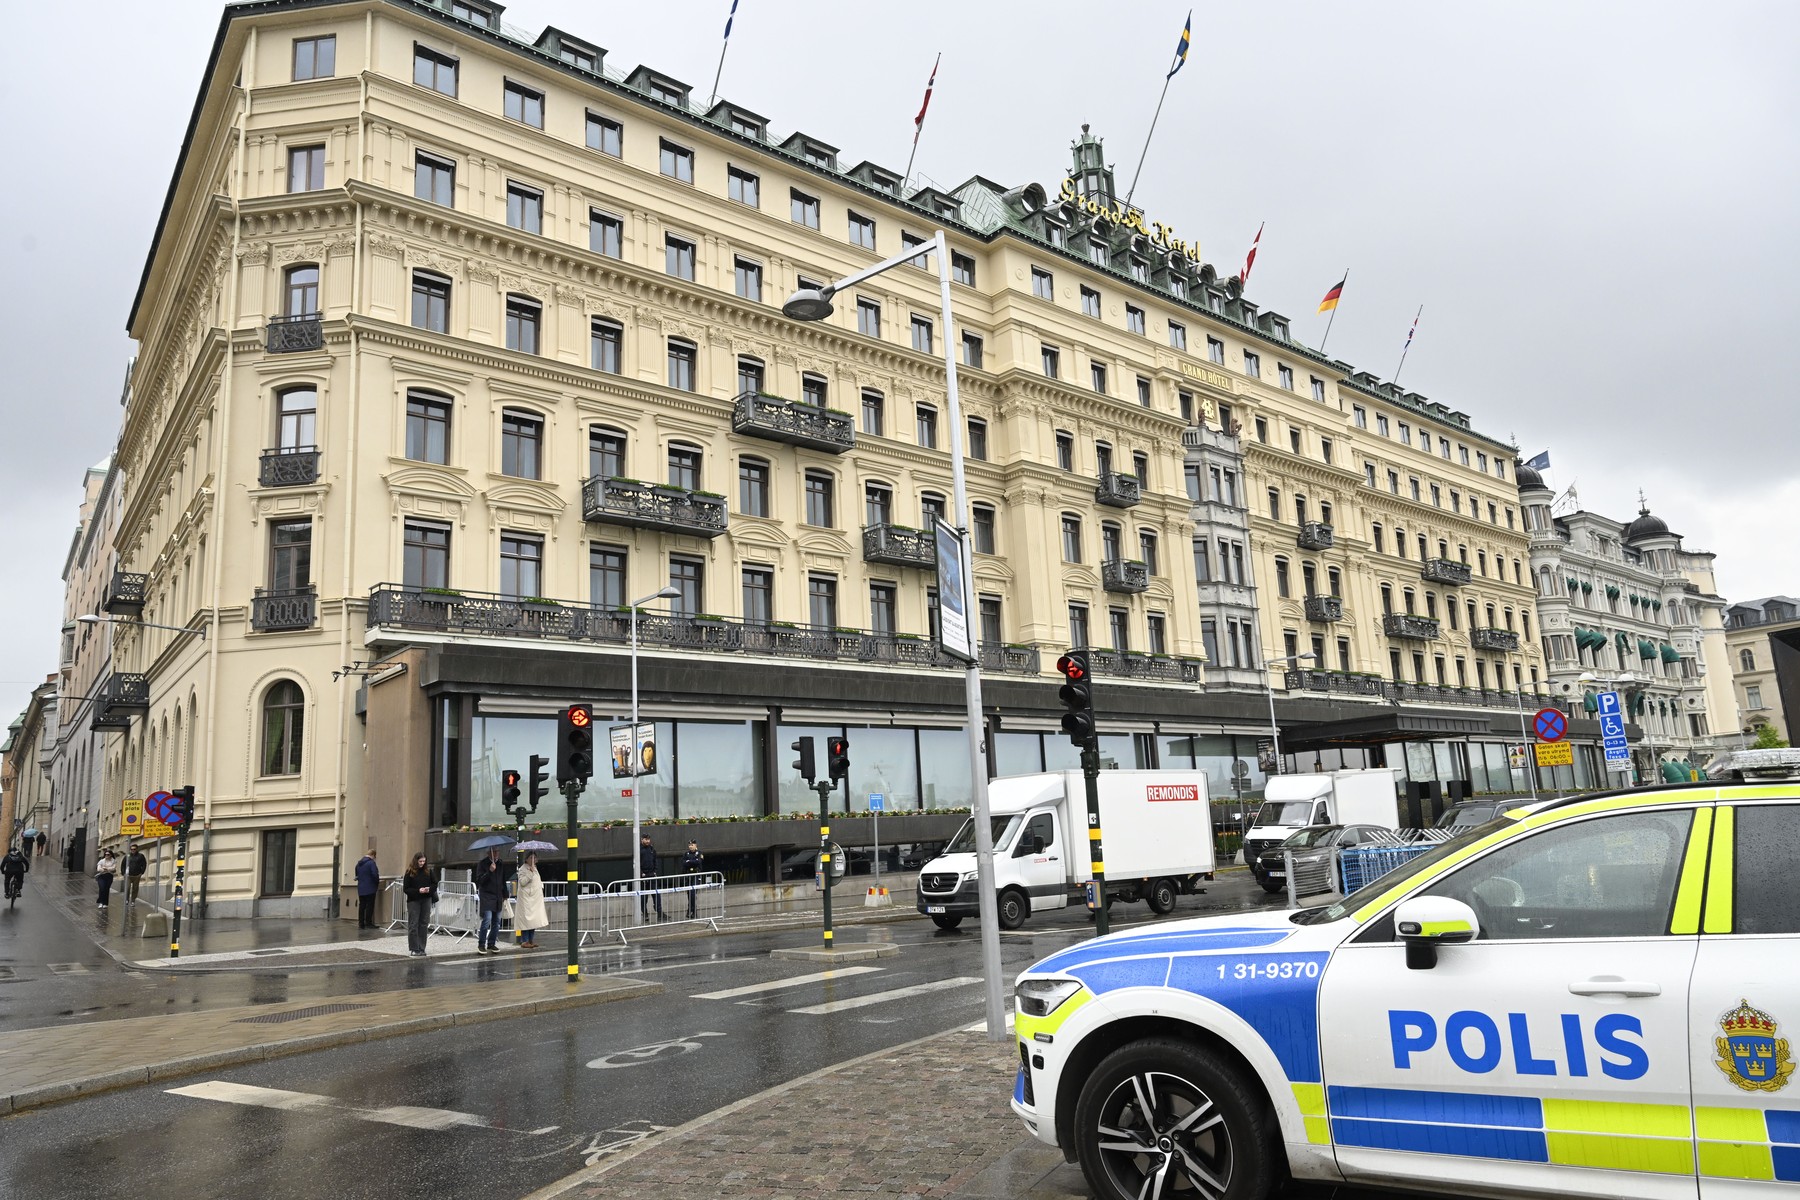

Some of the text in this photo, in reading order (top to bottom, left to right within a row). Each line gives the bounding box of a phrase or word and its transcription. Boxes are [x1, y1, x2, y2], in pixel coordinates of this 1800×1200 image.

[1059, 177, 1122, 224] Grand
[1182, 363, 1207, 381] GRAND
[1602, 694, 1615, 713] P
[1217, 961, 1319, 979] 1 31-9370
[1388, 1009, 1649, 1081] POLIS
